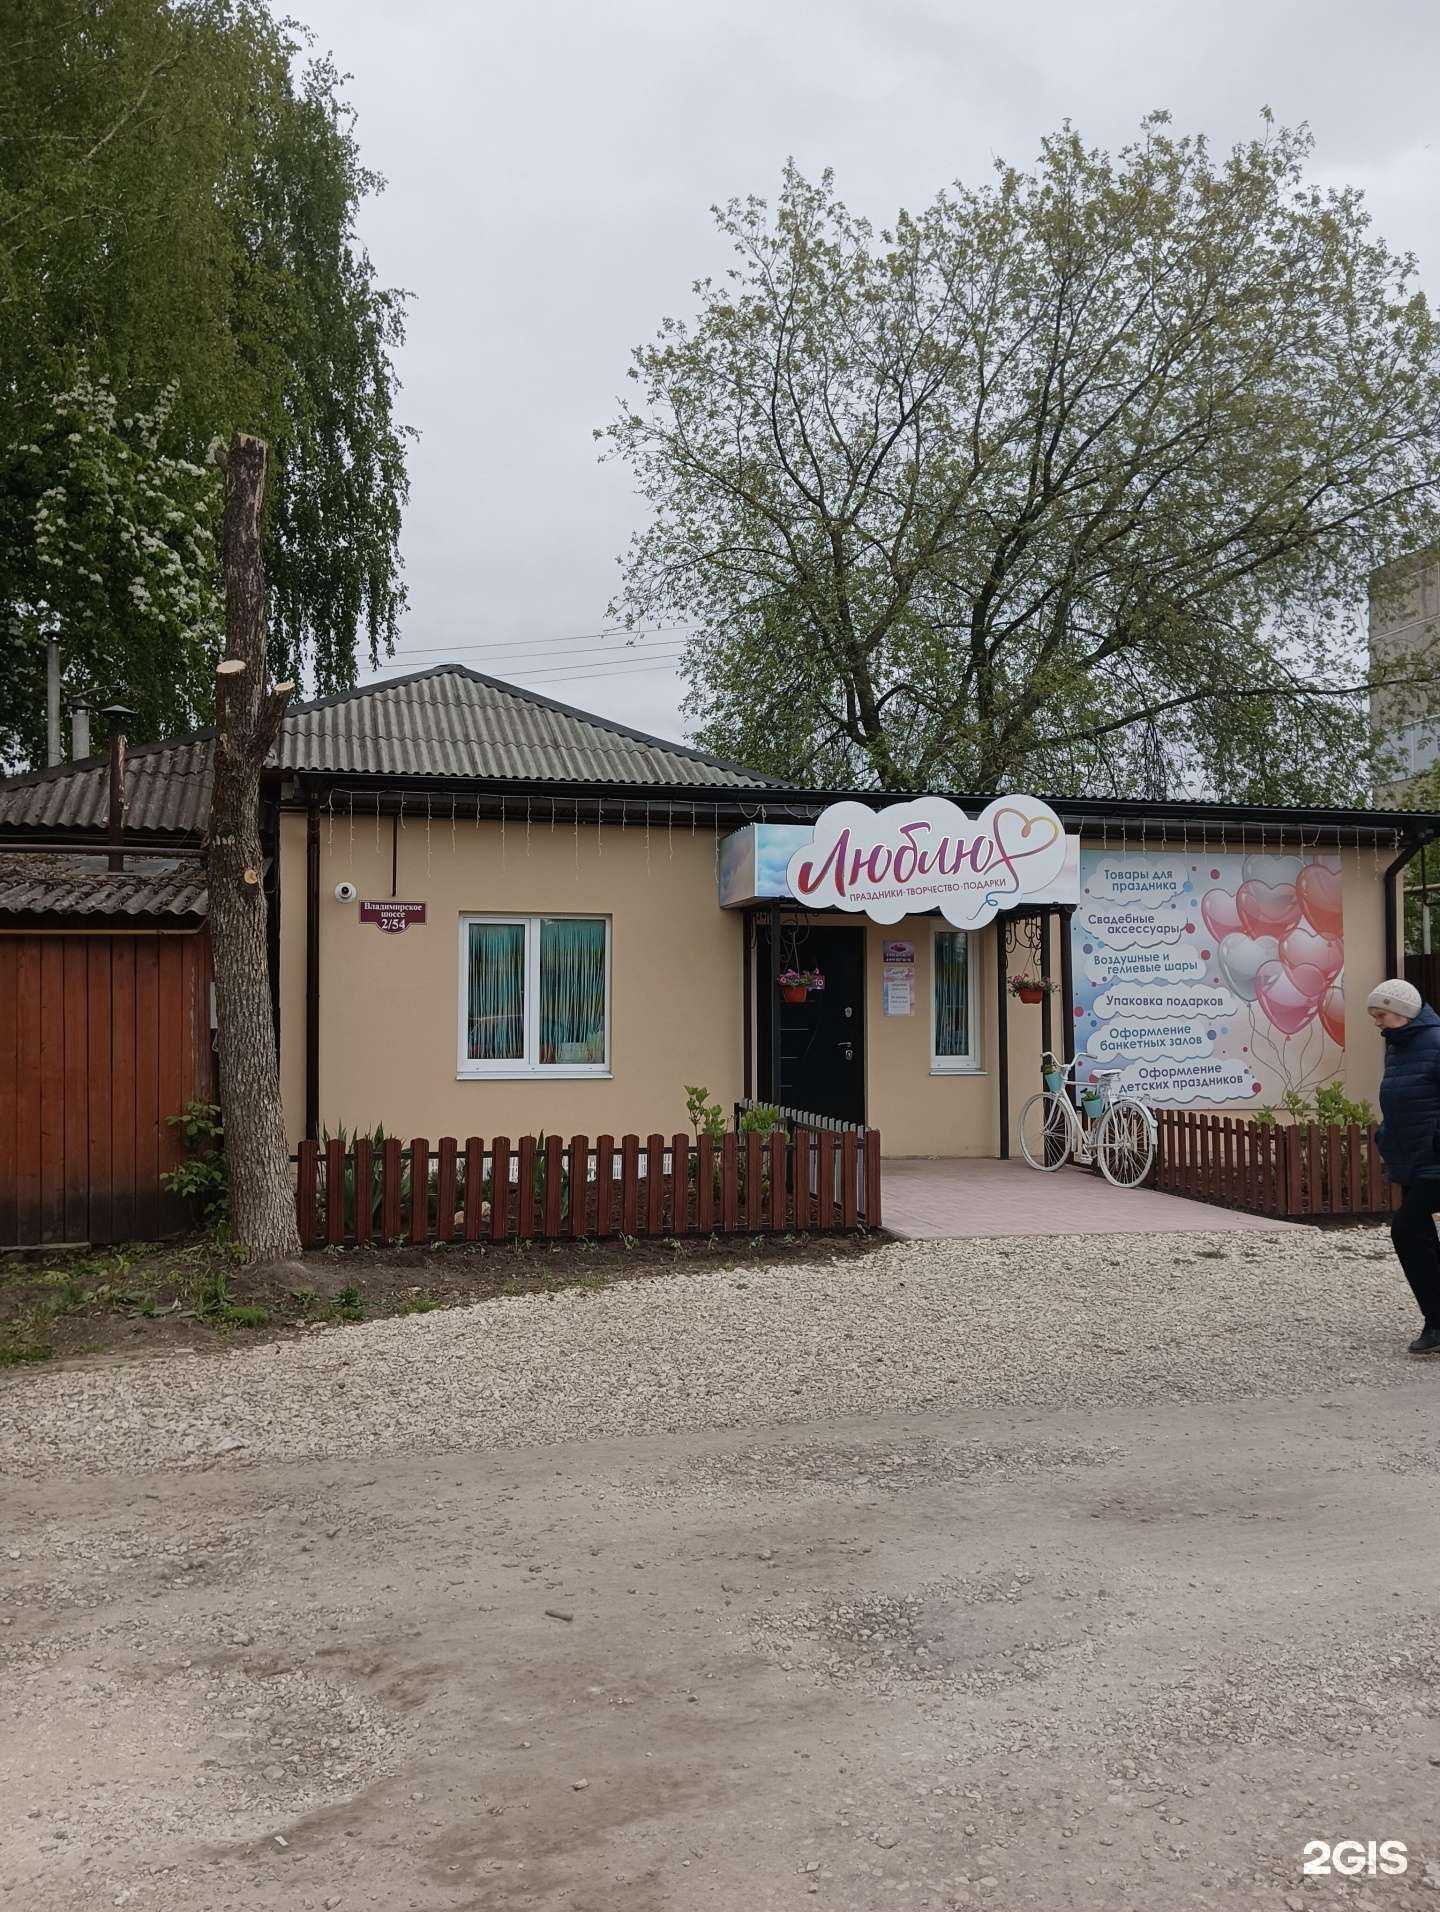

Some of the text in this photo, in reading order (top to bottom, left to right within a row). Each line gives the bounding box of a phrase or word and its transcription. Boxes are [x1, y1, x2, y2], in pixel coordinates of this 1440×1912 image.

[797, 821, 994, 897] Люблю
[1104, 870, 1173, 881] Товары для
[850, 879, 1007, 902] ПРАЗДНИКИ ТВОРЧЕСТВО ПОДАРКИ
[1112, 881, 1177, 892] праздника
[364, 902, 423, 912] Владимирское
[381, 919, 406, 930] 2/54
[1088, 914, 1155, 925] Свадебные
[1107, 924, 1180, 936] аксессуары
[1094, 953, 1170, 966] Воздушные и
[1107, 961, 1198, 975] гелиевые шары
[1106, 995, 1224, 1008] Упаковка подарков
[1109, 1025, 1192, 1040] Оформление
[1100, 1036, 1203, 1051] банкетных залов
[1138, 1065, 1222, 1080] Оформление
[1119, 1075, 1244, 1093] детских праздников
